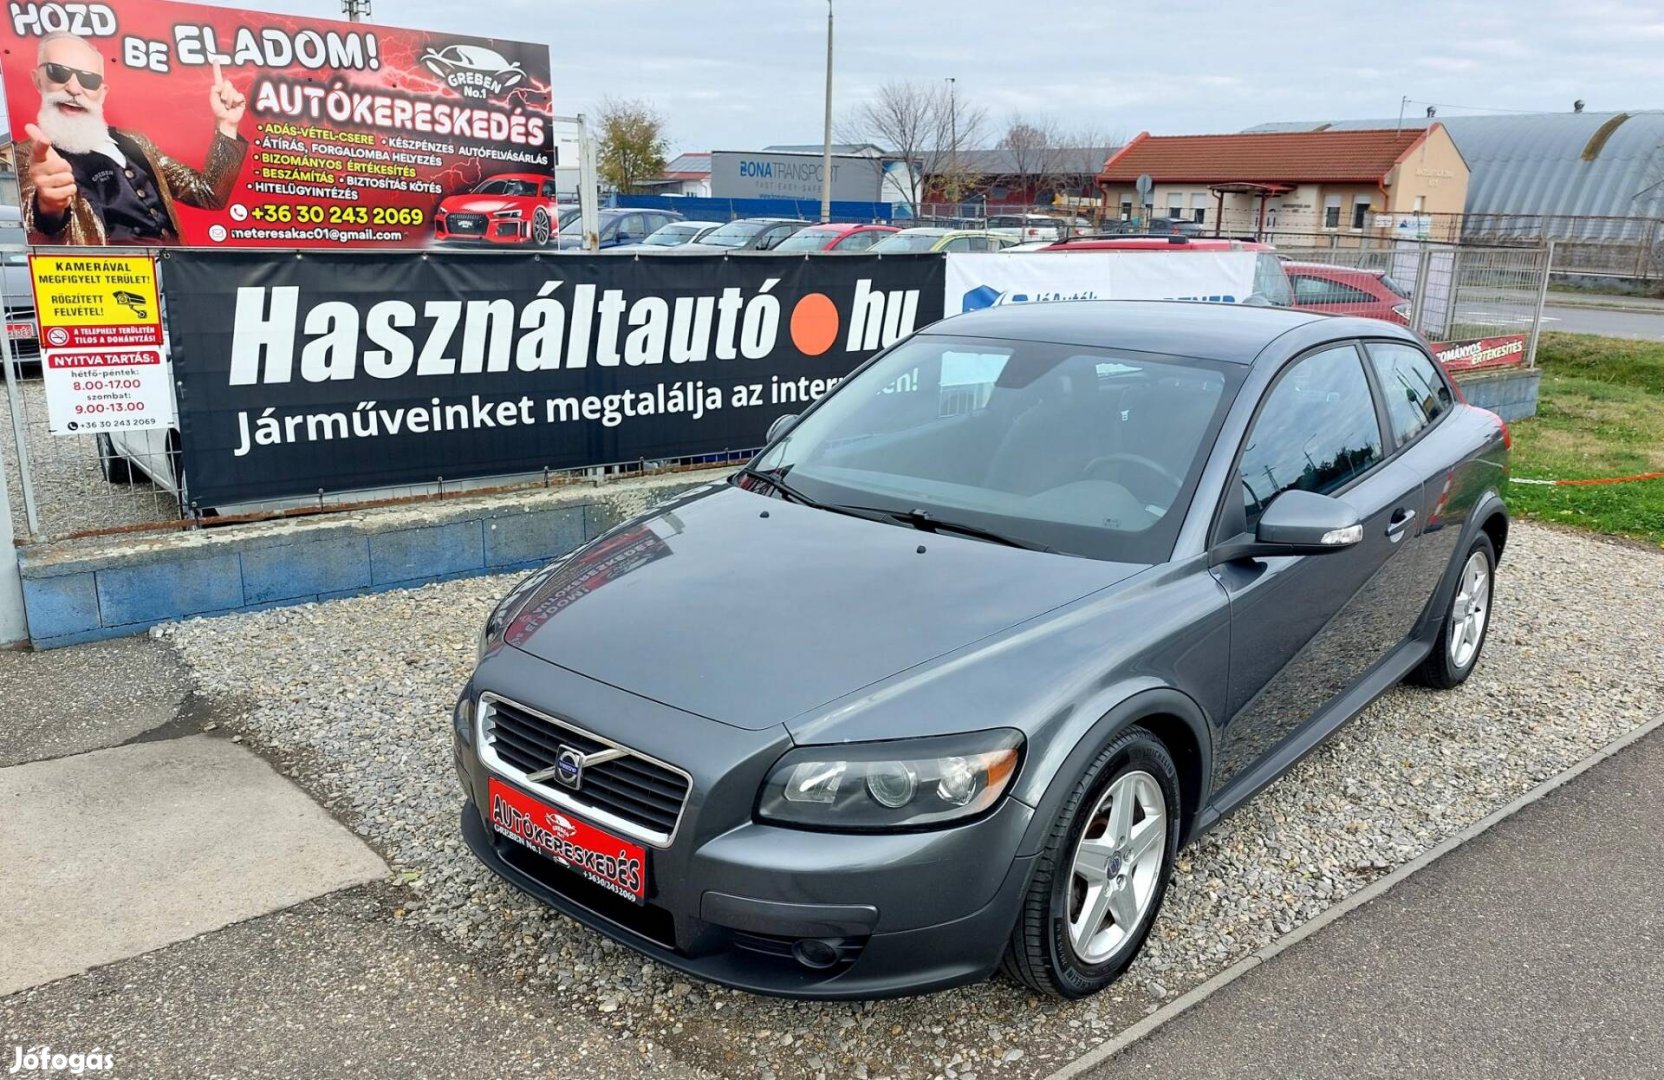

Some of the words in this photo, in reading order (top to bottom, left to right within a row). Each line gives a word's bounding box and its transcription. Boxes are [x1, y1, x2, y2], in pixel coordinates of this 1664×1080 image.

[10, 3, 117, 36] HOZD
[123, 36, 169, 72] BE
[174, 25, 379, 69] ELADOM!
[447, 72, 502, 94] GREBEN
[464, 85, 487, 99] No.1
[256, 81, 545, 147] AUTÓKERESKEDÉS
[264, 123, 375, 145] ADÁS-VÉTEL-CSERE
[262, 136, 308, 154] ÁTÍRÁS,
[311, 144, 391, 161] FORGALOMBA
[392, 152, 443, 167] HELYEZÉS
[388, 138, 455, 155] KÉSZPÉNZES
[458, 145, 549, 165] AUTÓFELVÁSÁRLÁS
[261, 152, 343, 170] BIZOMÁNYOS
[347, 160, 416, 178] ÉRTÉKESÍTÉS
[740, 161, 840, 182] BONATRANSPOT
[255, 182, 359, 200] HITELÜGYINTÉZÉS
[262, 168, 335, 184] BESZÁMÍTÁS
[346, 176, 408, 191] BIZTOSÍTÁS
[409, 181, 443, 194] KÖTÉS
[251, 205, 291, 223] +36
[296, 206, 324, 223] 30
[329, 206, 368, 224] 243
[372, 208, 424, 225] 2069
[55, 260, 132, 272] KAMERÁVAL
[38, 275, 101, 284] MEGFIGYELT
[106, 274, 150, 284] TERÜLET!
[51, 293, 104, 304] RÖGZÍTETT
[54, 305, 104, 317] FELVÉTEL!
[74, 336, 98, 344] TILOS
[54, 354, 103, 367] NYITVA
[105, 352, 154, 365] TARTÁS:
[73, 379, 141, 391] 8.00-17.00
[87, 392, 131, 401] szombat:
[75, 401, 145, 414] 9.00-13.00
[80, 421, 98, 429] +36
[100, 420, 112, 428] 30
[114, 419, 131, 427] 243
[133, 418, 156, 426] 2069
[234, 395, 535, 457] Járműveinket
[546, 381, 722, 427] megtalálja
[731, 383, 764, 408] az
[493, 793, 641, 893] AUTÓKERESKEDÉS
